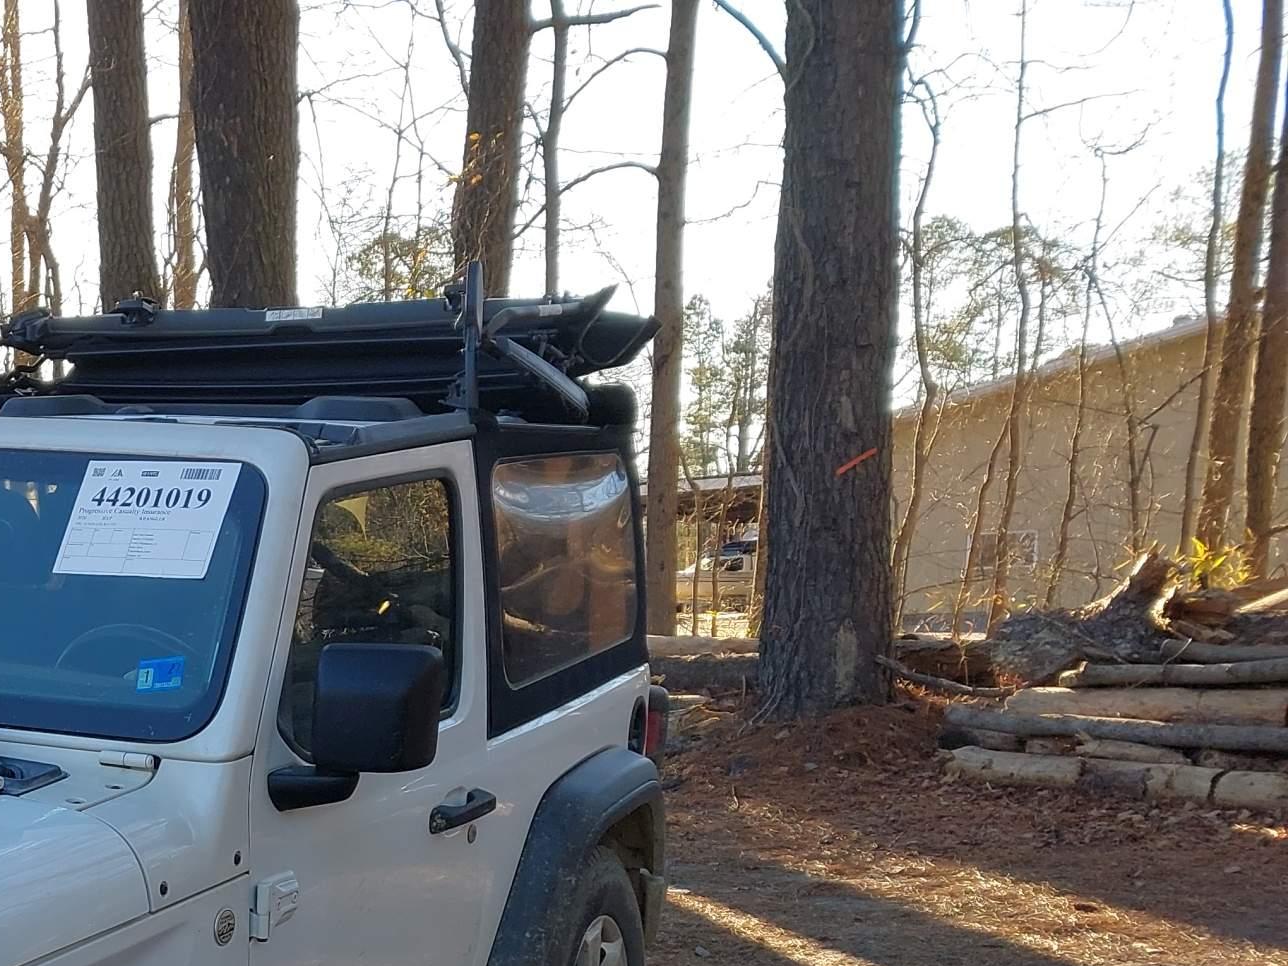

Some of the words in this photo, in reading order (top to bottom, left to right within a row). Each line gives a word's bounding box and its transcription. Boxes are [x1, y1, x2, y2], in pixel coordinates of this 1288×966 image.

[91, 486, 212, 509] 44201019
[78, 507, 113, 516] Progressive
[114, 508, 140, 516] Casualty
